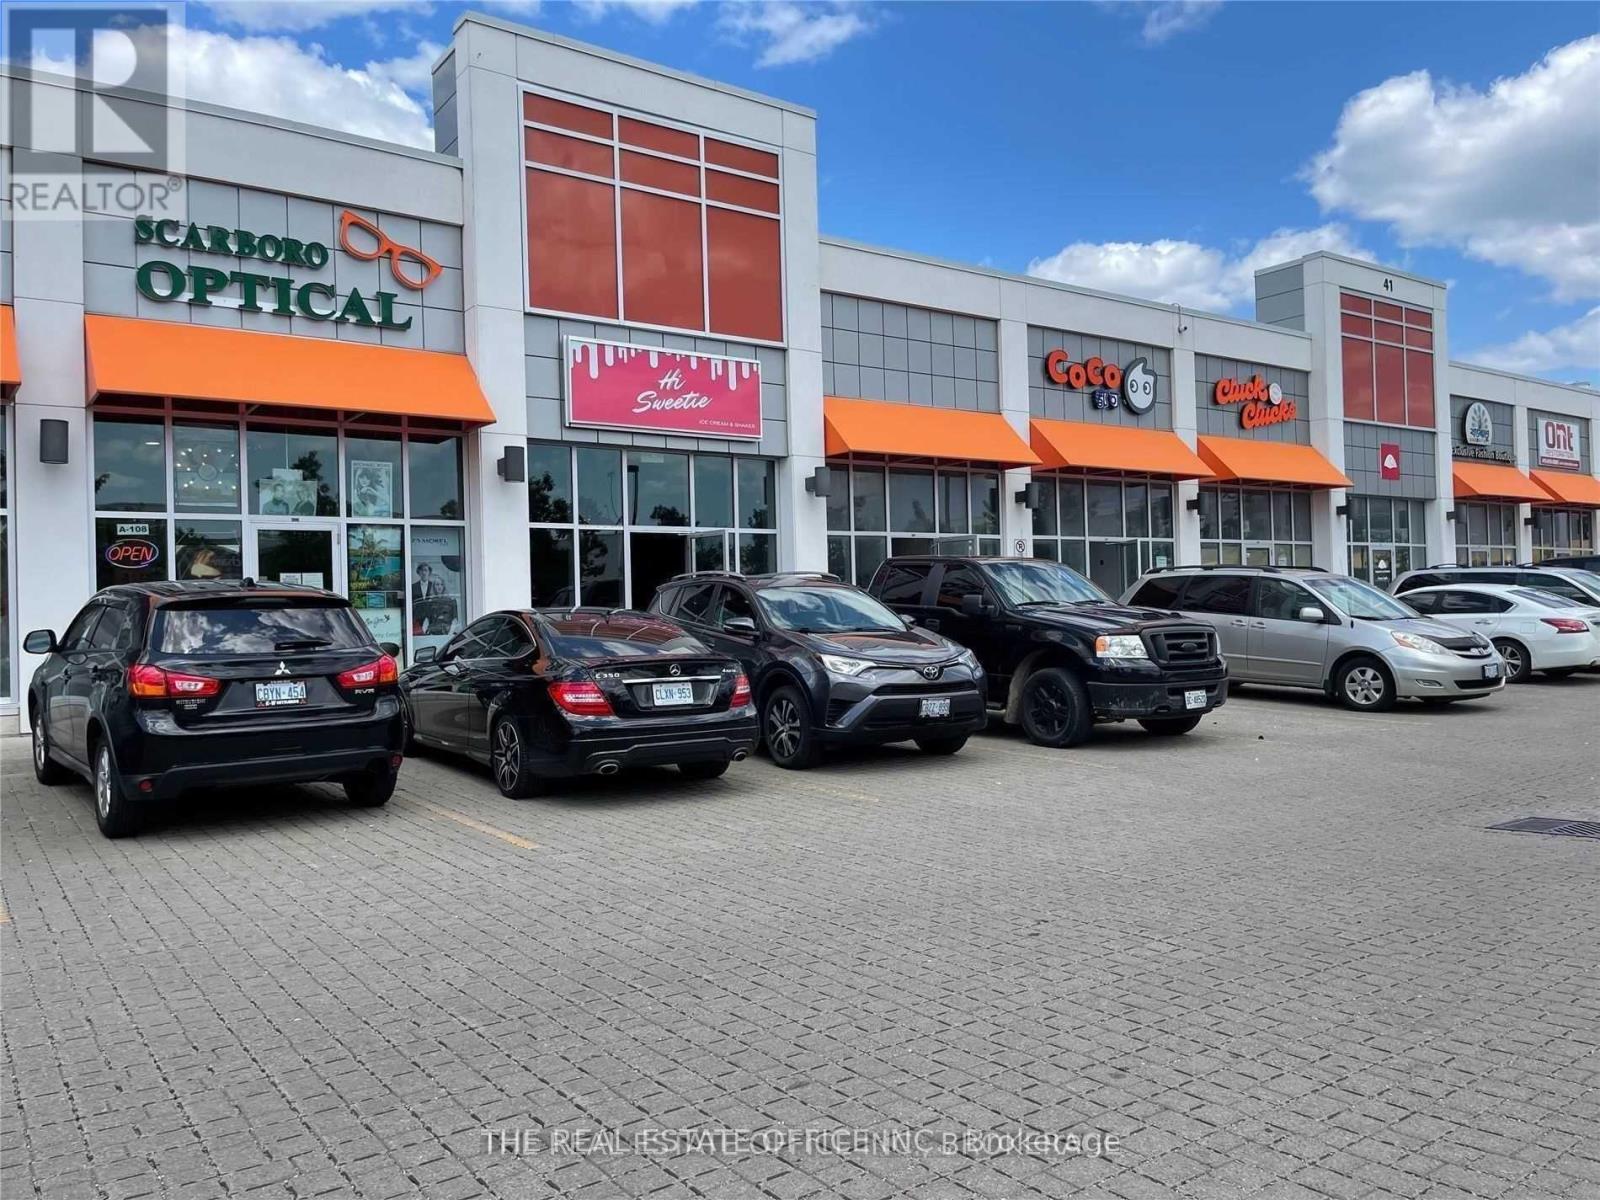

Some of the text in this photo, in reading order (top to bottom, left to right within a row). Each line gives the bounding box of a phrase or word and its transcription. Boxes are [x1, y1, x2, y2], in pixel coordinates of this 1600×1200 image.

[134, 214, 329, 270] SCARBORO
[135, 260, 413, 332] OPTICAL
[1383, 278, 1393, 292] 41
[658, 367, 686, 391] Hi
[632, 390, 712, 413] Sweetie
[118, 525, 148, 534] A-108
[108, 546, 153, 561] OPEN
